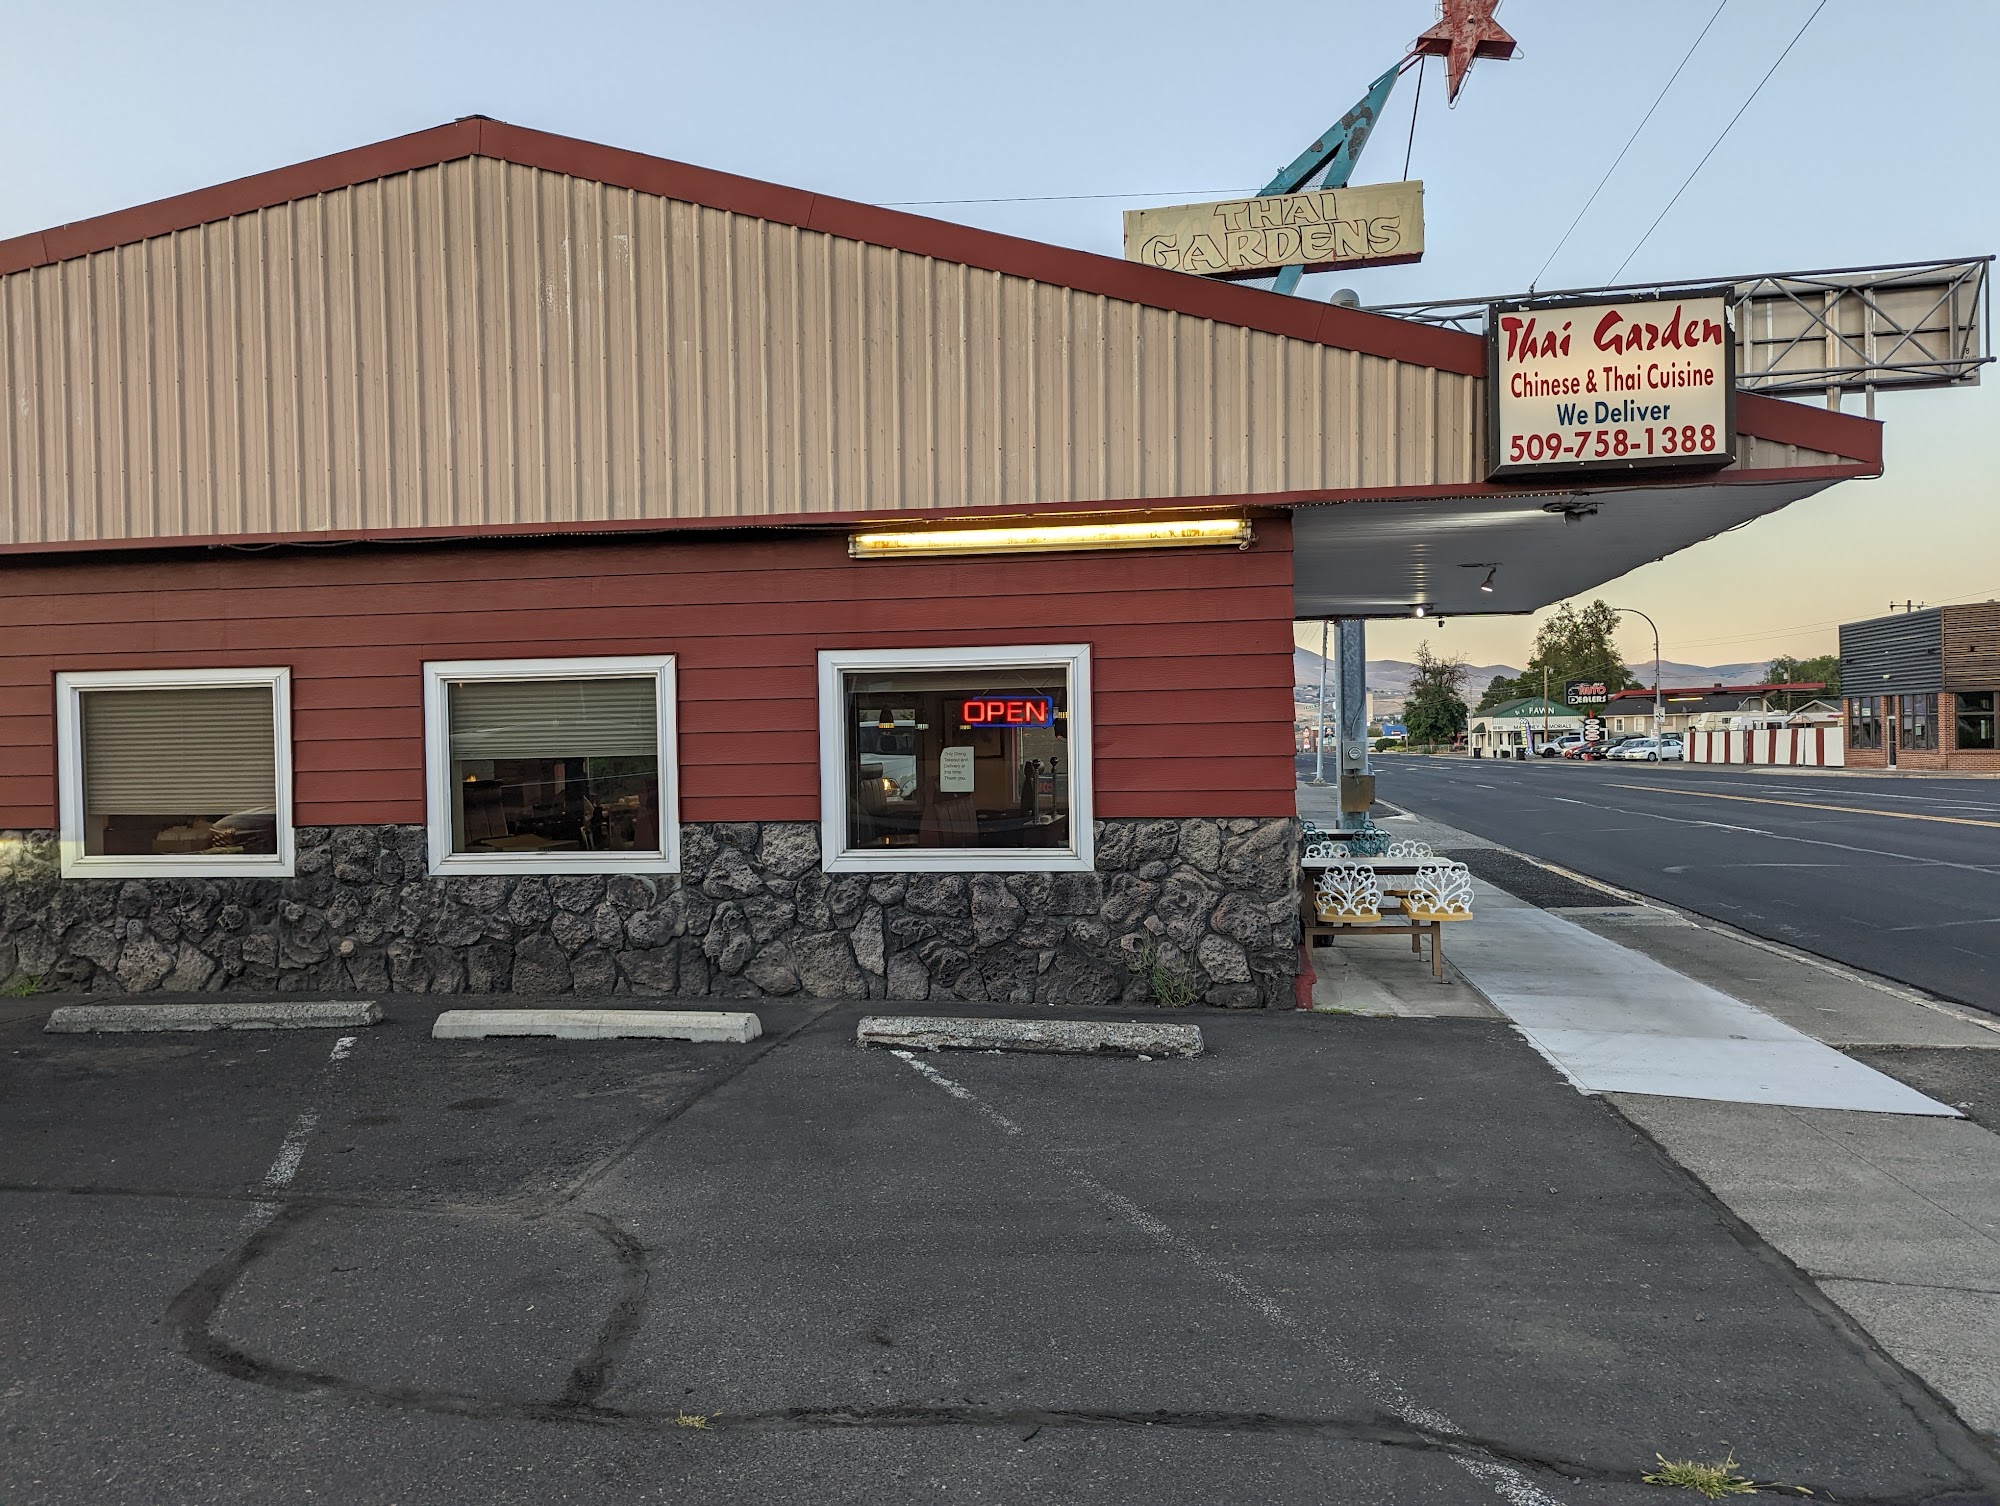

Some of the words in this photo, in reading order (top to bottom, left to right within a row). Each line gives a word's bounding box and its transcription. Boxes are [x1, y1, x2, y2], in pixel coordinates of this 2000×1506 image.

[1213, 192, 1339, 231] THAI
[1141, 214, 1401, 271] GARDENS
[1500, 316, 1572, 363] Thai
[1593, 304, 1723, 356] Garden
[1511, 371, 1580, 398] Chinese
[1586, 368, 1598, 394] &
[1603, 364, 1641, 392] Thai
[1647, 361, 1714, 389] Cuisine
[1556, 402, 1589, 426] We
[1595, 399, 1671, 424] Deliver
[1509, 424, 1716, 462] 509-758-1388
[1578, 685, 1606, 695] AUTO
[963, 701, 1046, 722] OPEN
